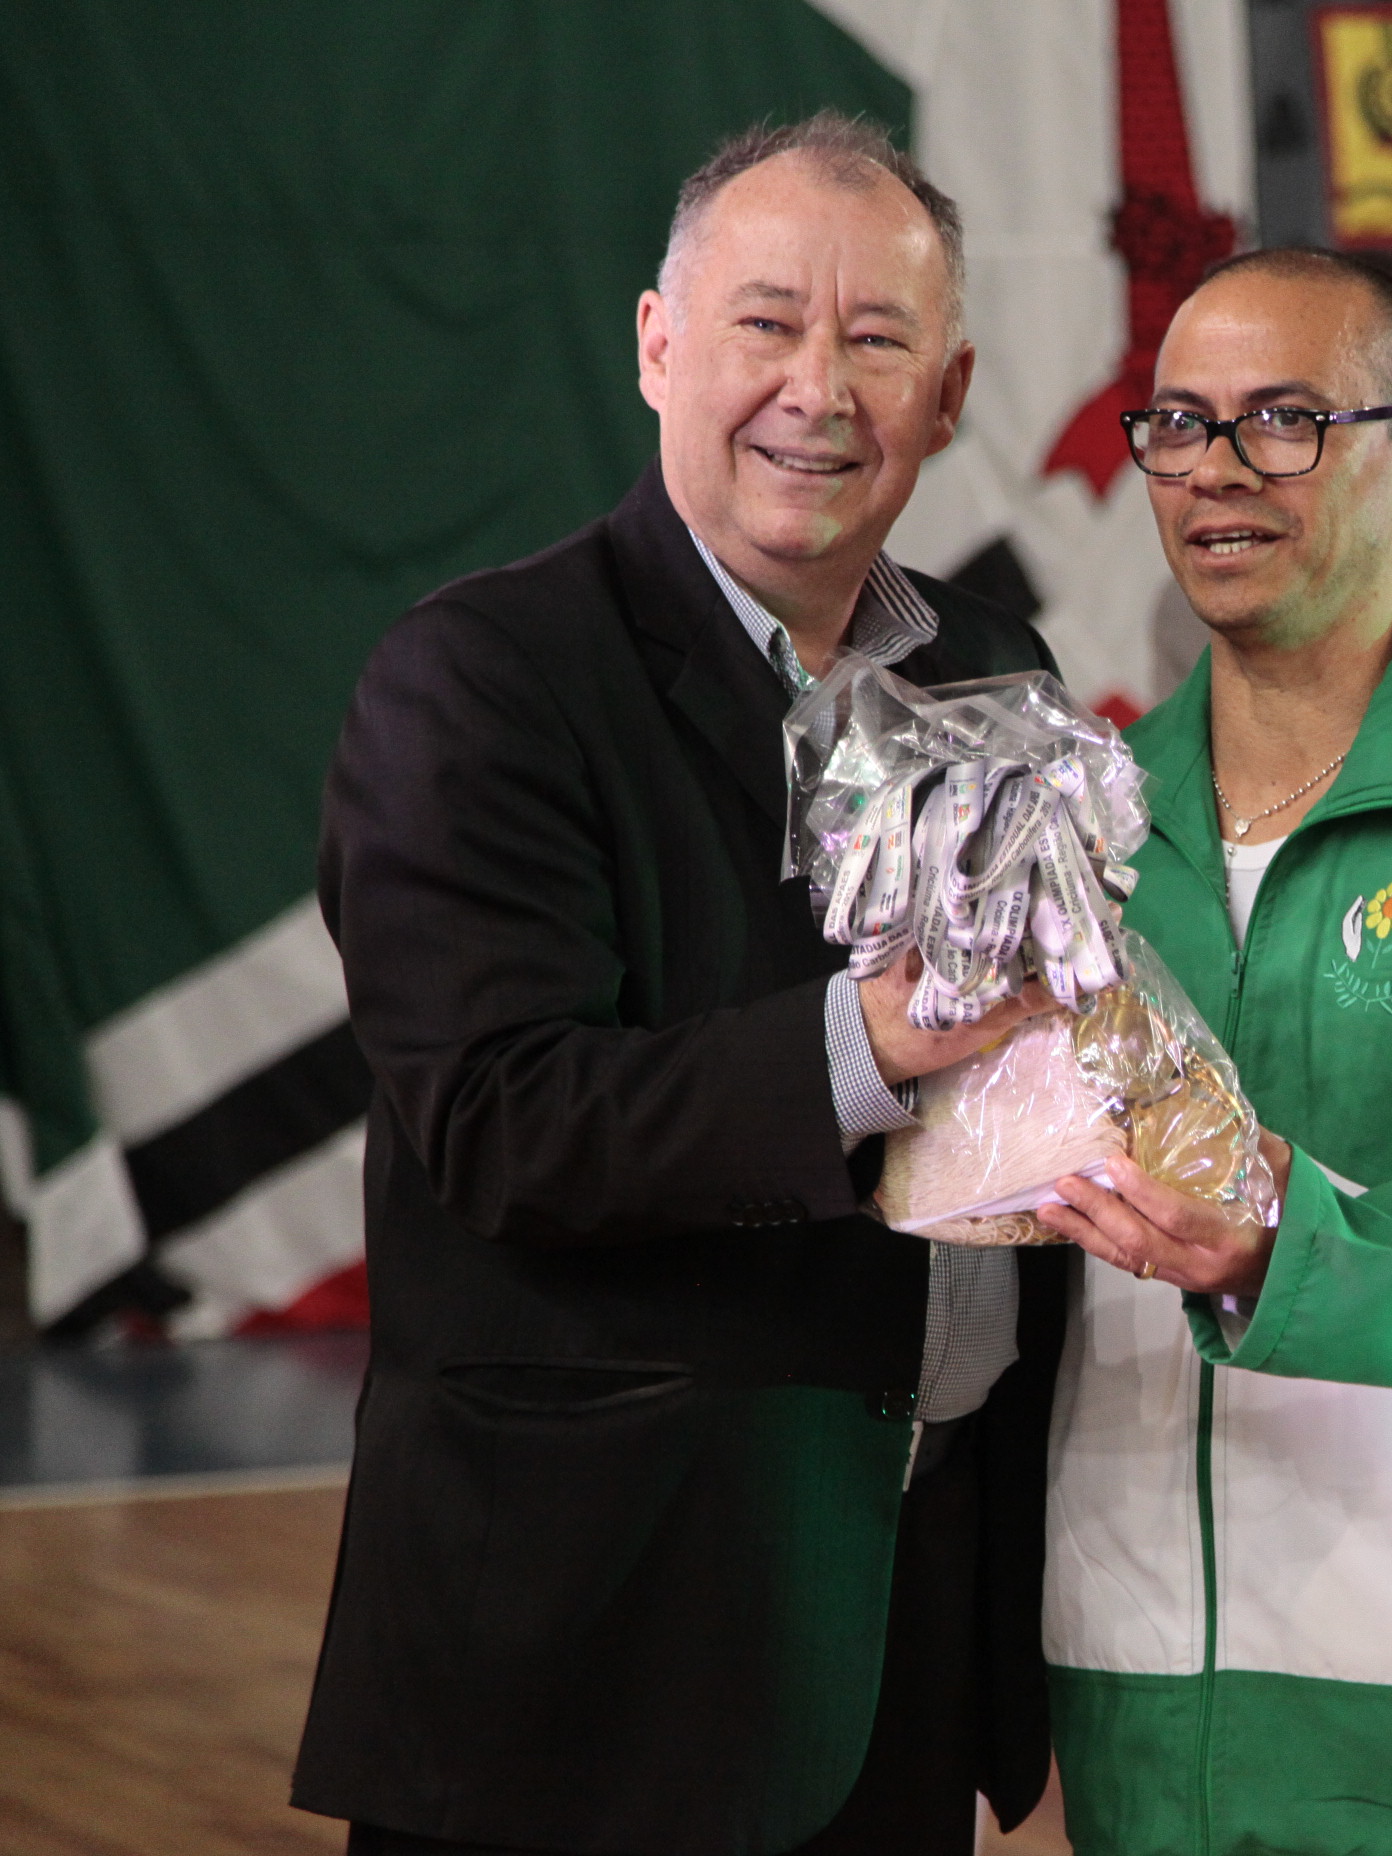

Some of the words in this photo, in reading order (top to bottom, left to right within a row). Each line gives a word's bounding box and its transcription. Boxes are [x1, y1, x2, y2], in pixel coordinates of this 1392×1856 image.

[1023, 804, 1036, 822] DAS
[922, 865, 940, 907] Criciúma
[1063, 870, 1082, 914] Criciúma
[1100, 919, 1115, 943] 2015
